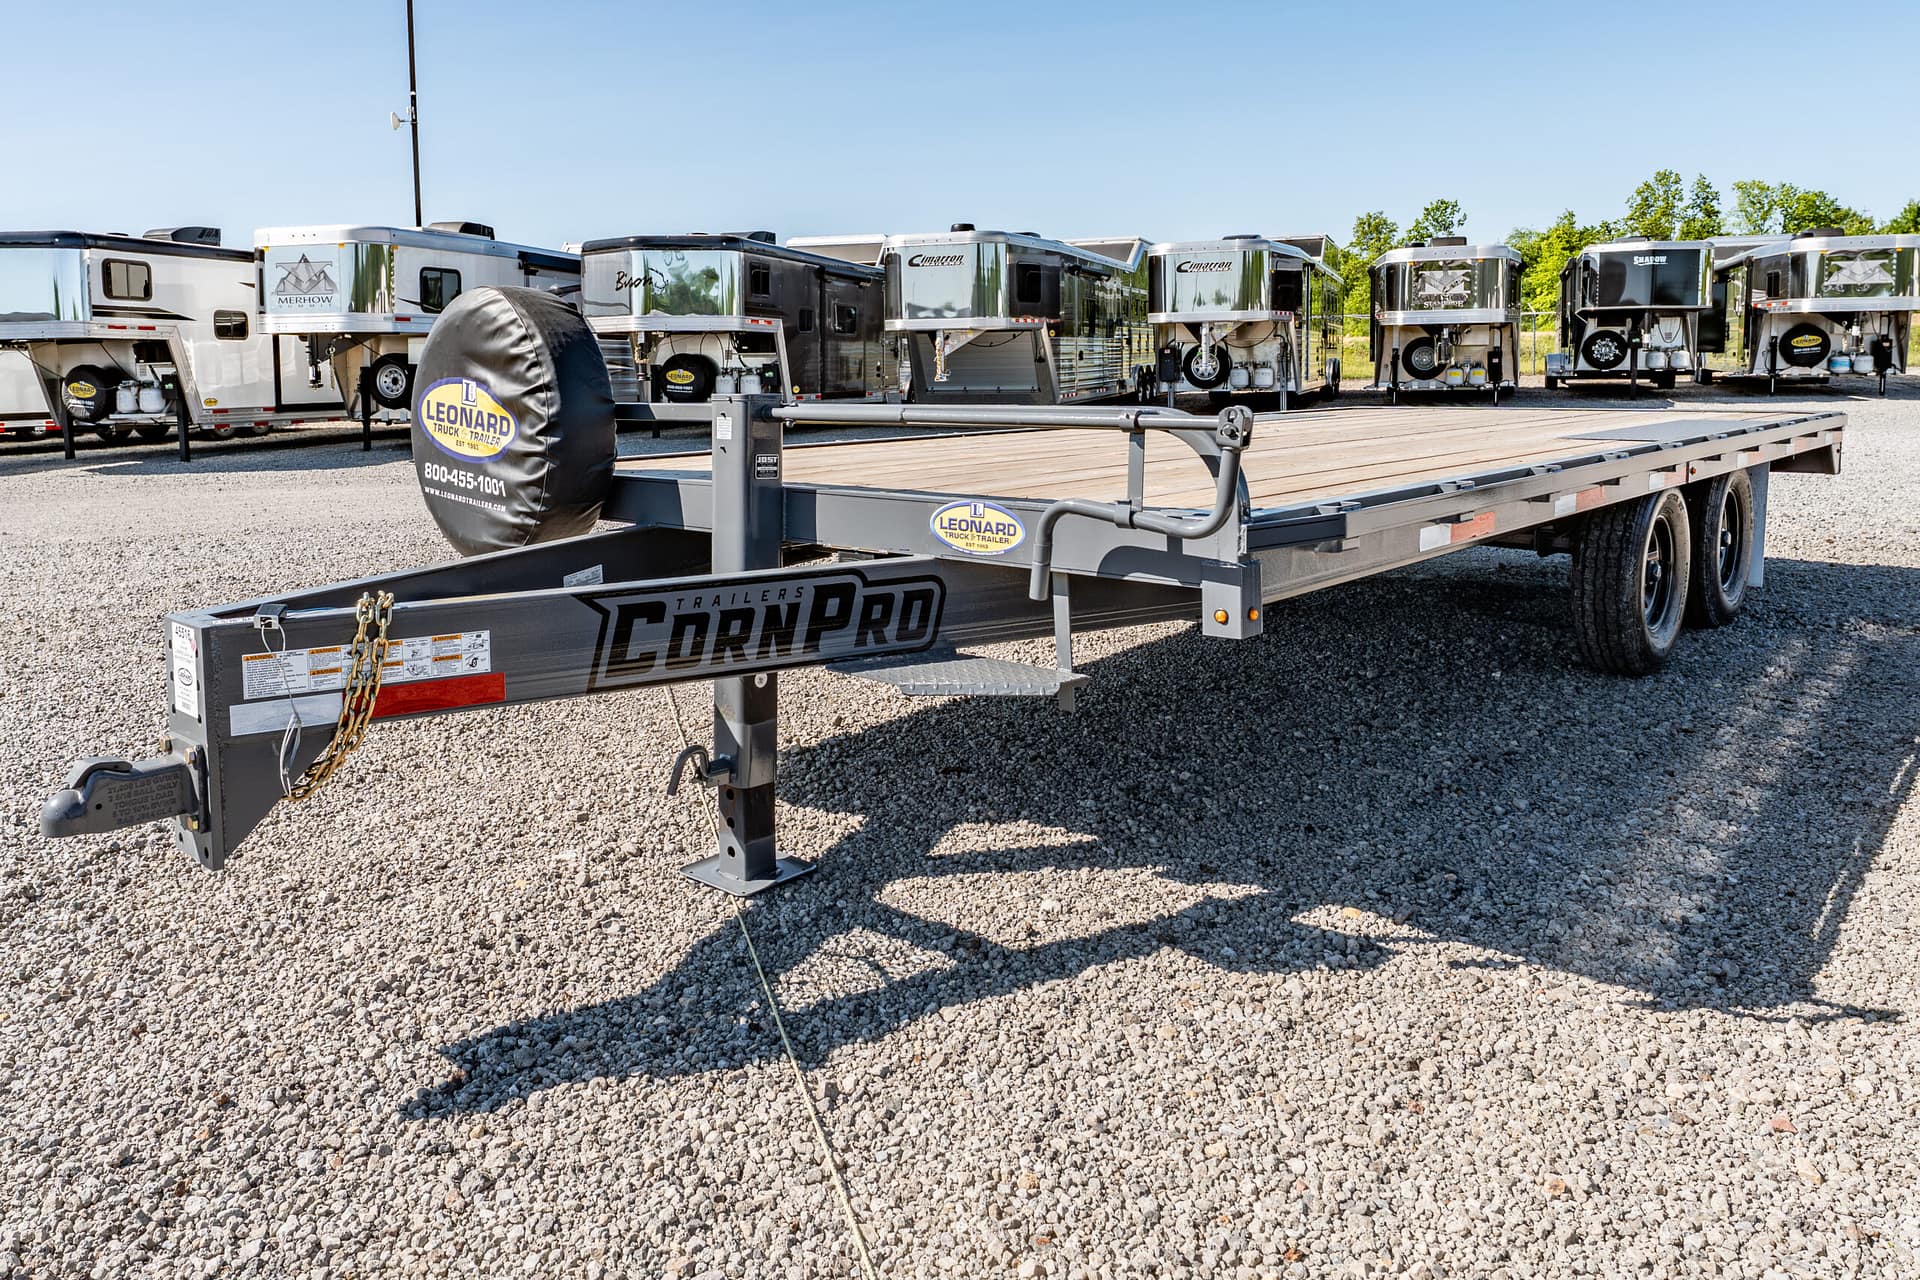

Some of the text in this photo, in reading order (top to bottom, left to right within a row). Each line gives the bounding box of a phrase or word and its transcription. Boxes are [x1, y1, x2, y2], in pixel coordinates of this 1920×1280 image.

[907, 254, 964, 267] Cimarron
[1176, 260, 1232, 273] Cimarron
[1633, 255, 1667, 265] SHADOW
[277, 295, 333, 305] MERHOW
[426, 399, 511, 437] LEONARD
[433, 422, 460, 438] TRUCK
[469, 430, 501, 447] TRAILER
[455, 439, 465, 447] EST
[757, 456, 778, 464] JOST
[424, 462, 507, 498] 800-455-1001
[423, 486, 507, 513] WWW.LEONARDTRAILERS.COM
[939, 516, 1017, 537] LEONARD
[944, 531, 969, 540] TRUCK
[976, 534, 1010, 545] TRAILER
[676, 586, 804, 610] TRAILERS
[151, 790, 174, 800] LOAD
